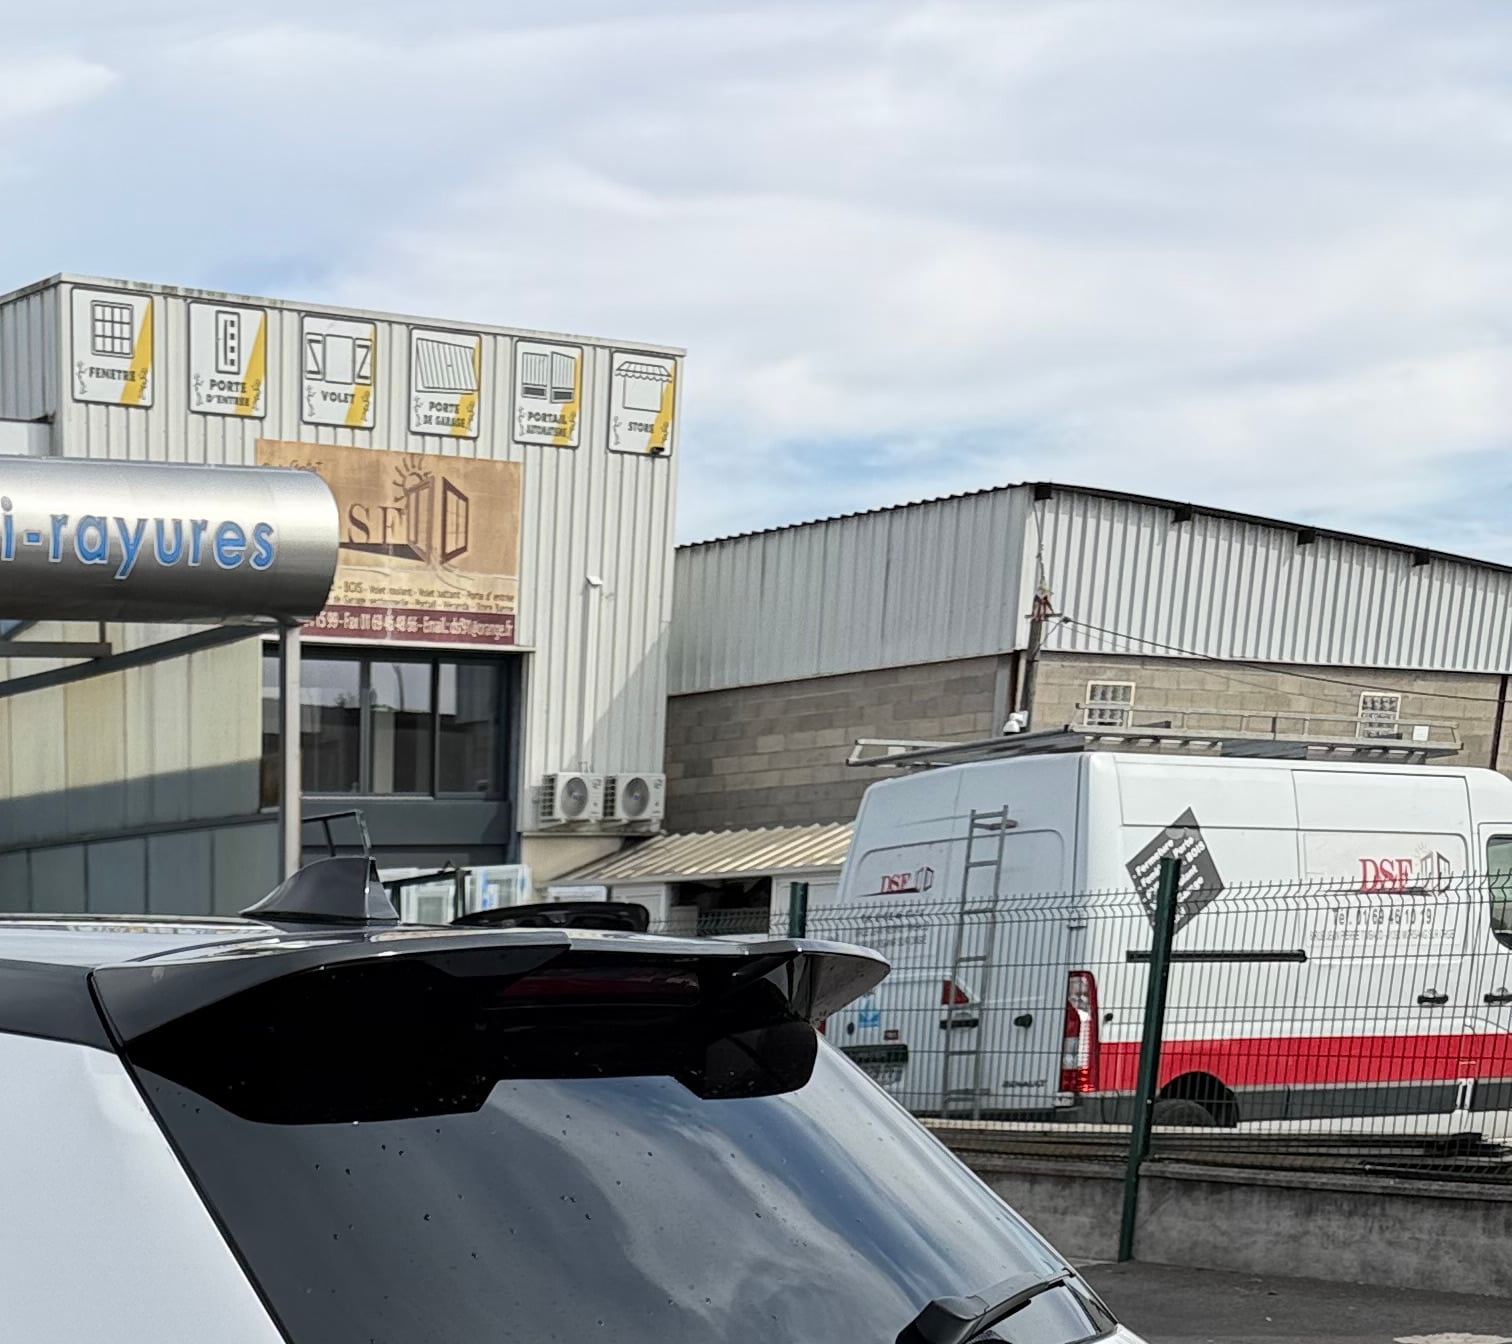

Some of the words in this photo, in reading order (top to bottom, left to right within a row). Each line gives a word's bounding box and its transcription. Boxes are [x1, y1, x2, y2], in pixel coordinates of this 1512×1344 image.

[209, 379, 247, 394] PORTE
[321, 390, 356, 405] VOLET
[428, 401, 459, 415] PORTE
[1185, 841, 1206, 863] BOIS
[1359, 858, 1413, 894] DSF
